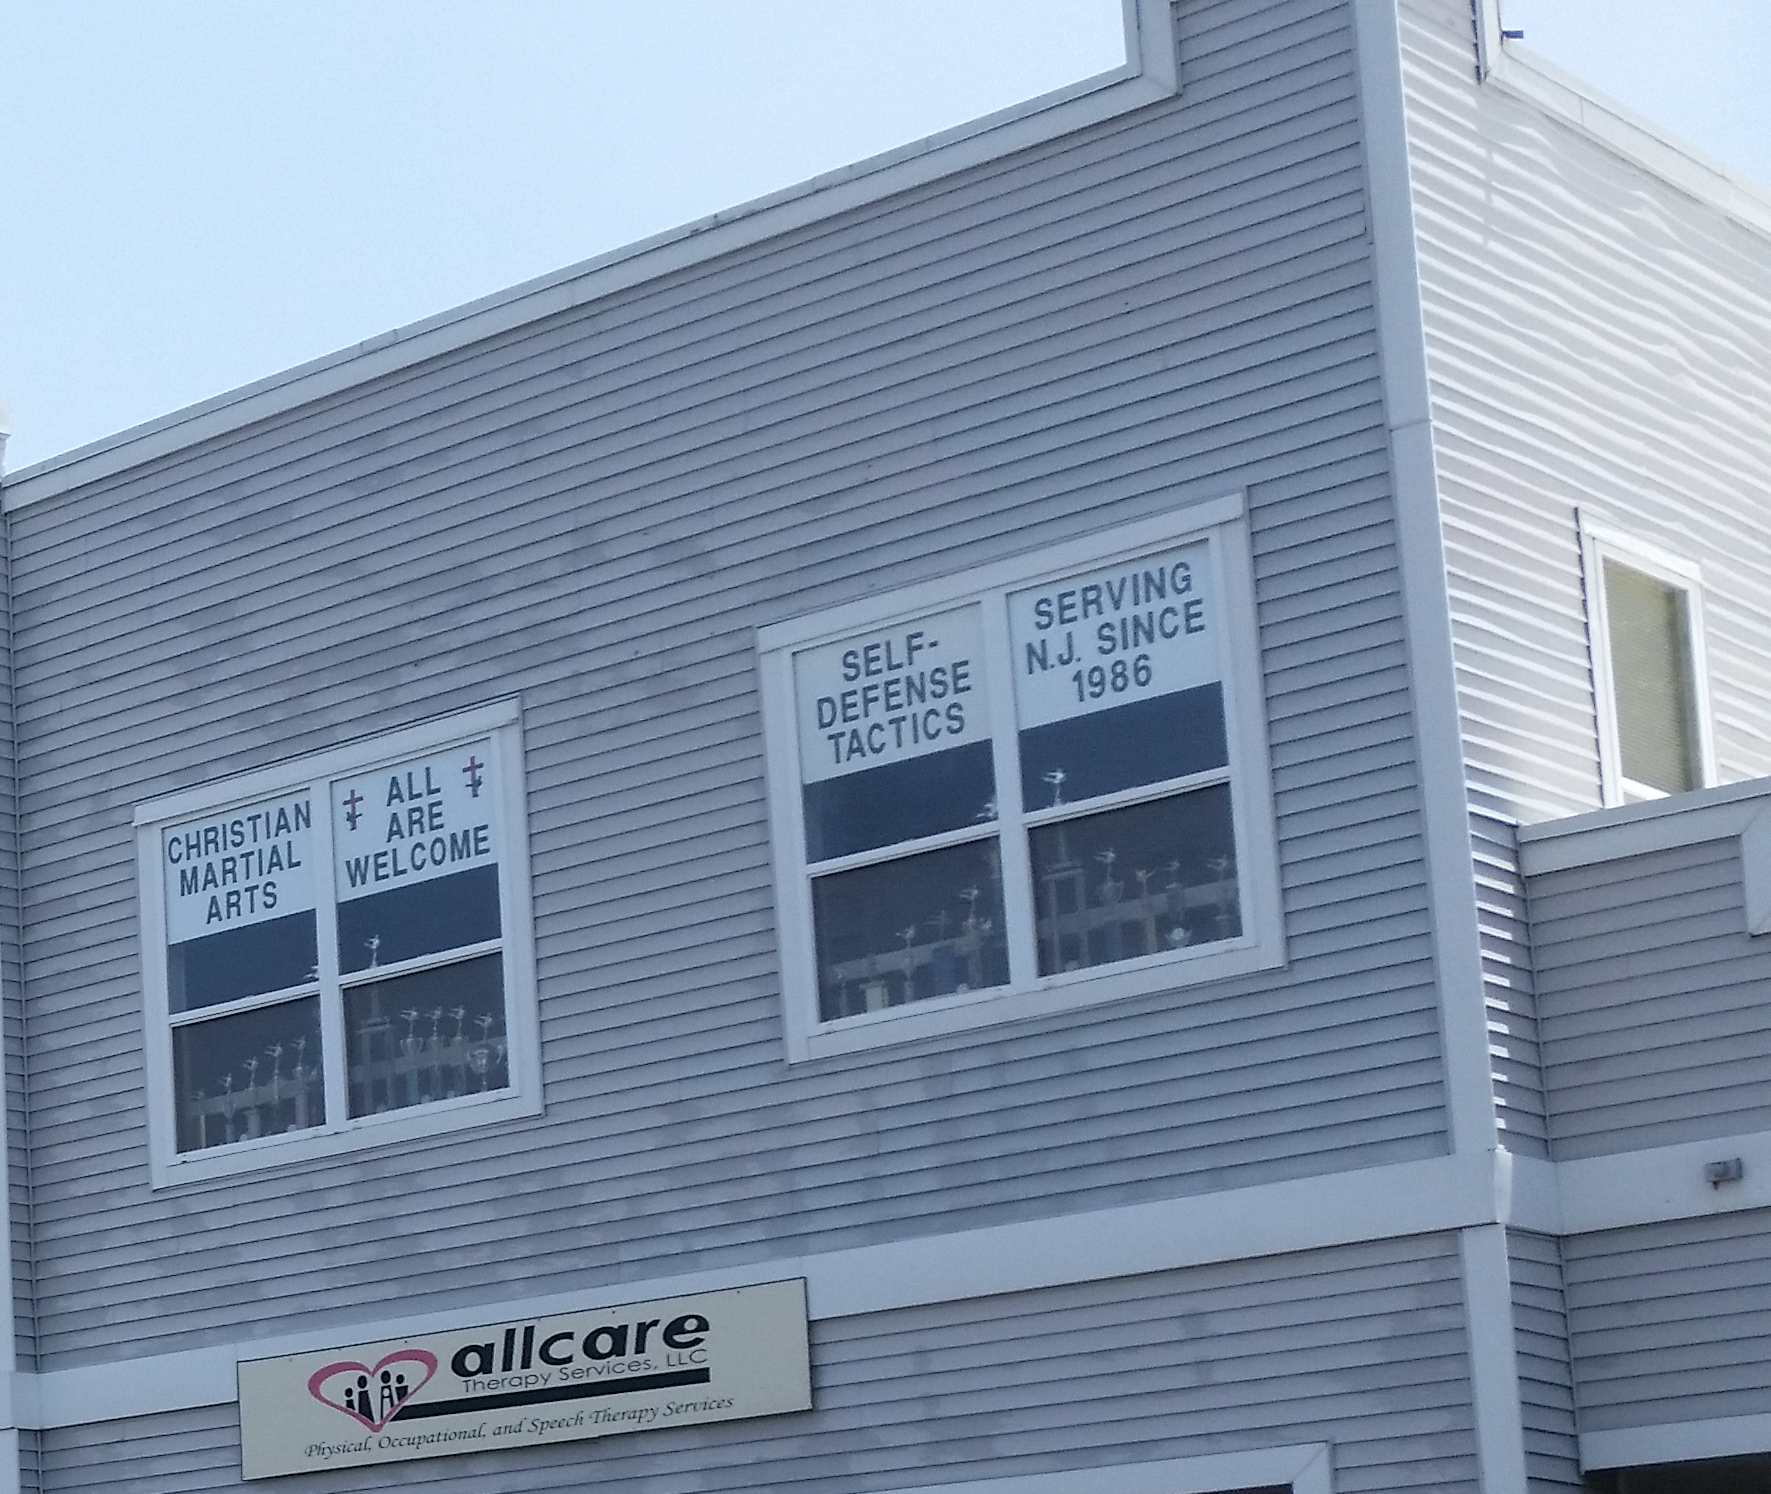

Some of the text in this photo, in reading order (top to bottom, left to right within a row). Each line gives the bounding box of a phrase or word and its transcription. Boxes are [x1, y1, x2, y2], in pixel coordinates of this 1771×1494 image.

[1034, 561, 1193, 631] SERVING
[841, 631, 939, 682] SELF-
[1026, 598, 1206, 675] N.J. SINCE
[817, 660, 972, 729] DEFENSE
[1071, 653, 1153, 702] 1986
[828, 702, 966, 765] TACTICS
[386, 767, 442, 806] ALL
[168, 800, 311, 864] CHRISTIAN
[387, 800, 444, 843] ARE
[180, 841, 302, 897] MARTIAL
[345, 824, 491, 888] WELCOME
[206, 881, 278, 925] ARTS
[451, 1314, 710, 1378] allcare
[462, 1349, 708, 1393] Therapy Services, LLC
[305, 1396, 735, 1460] Physical, Occupational, and Speech Therapy Services
